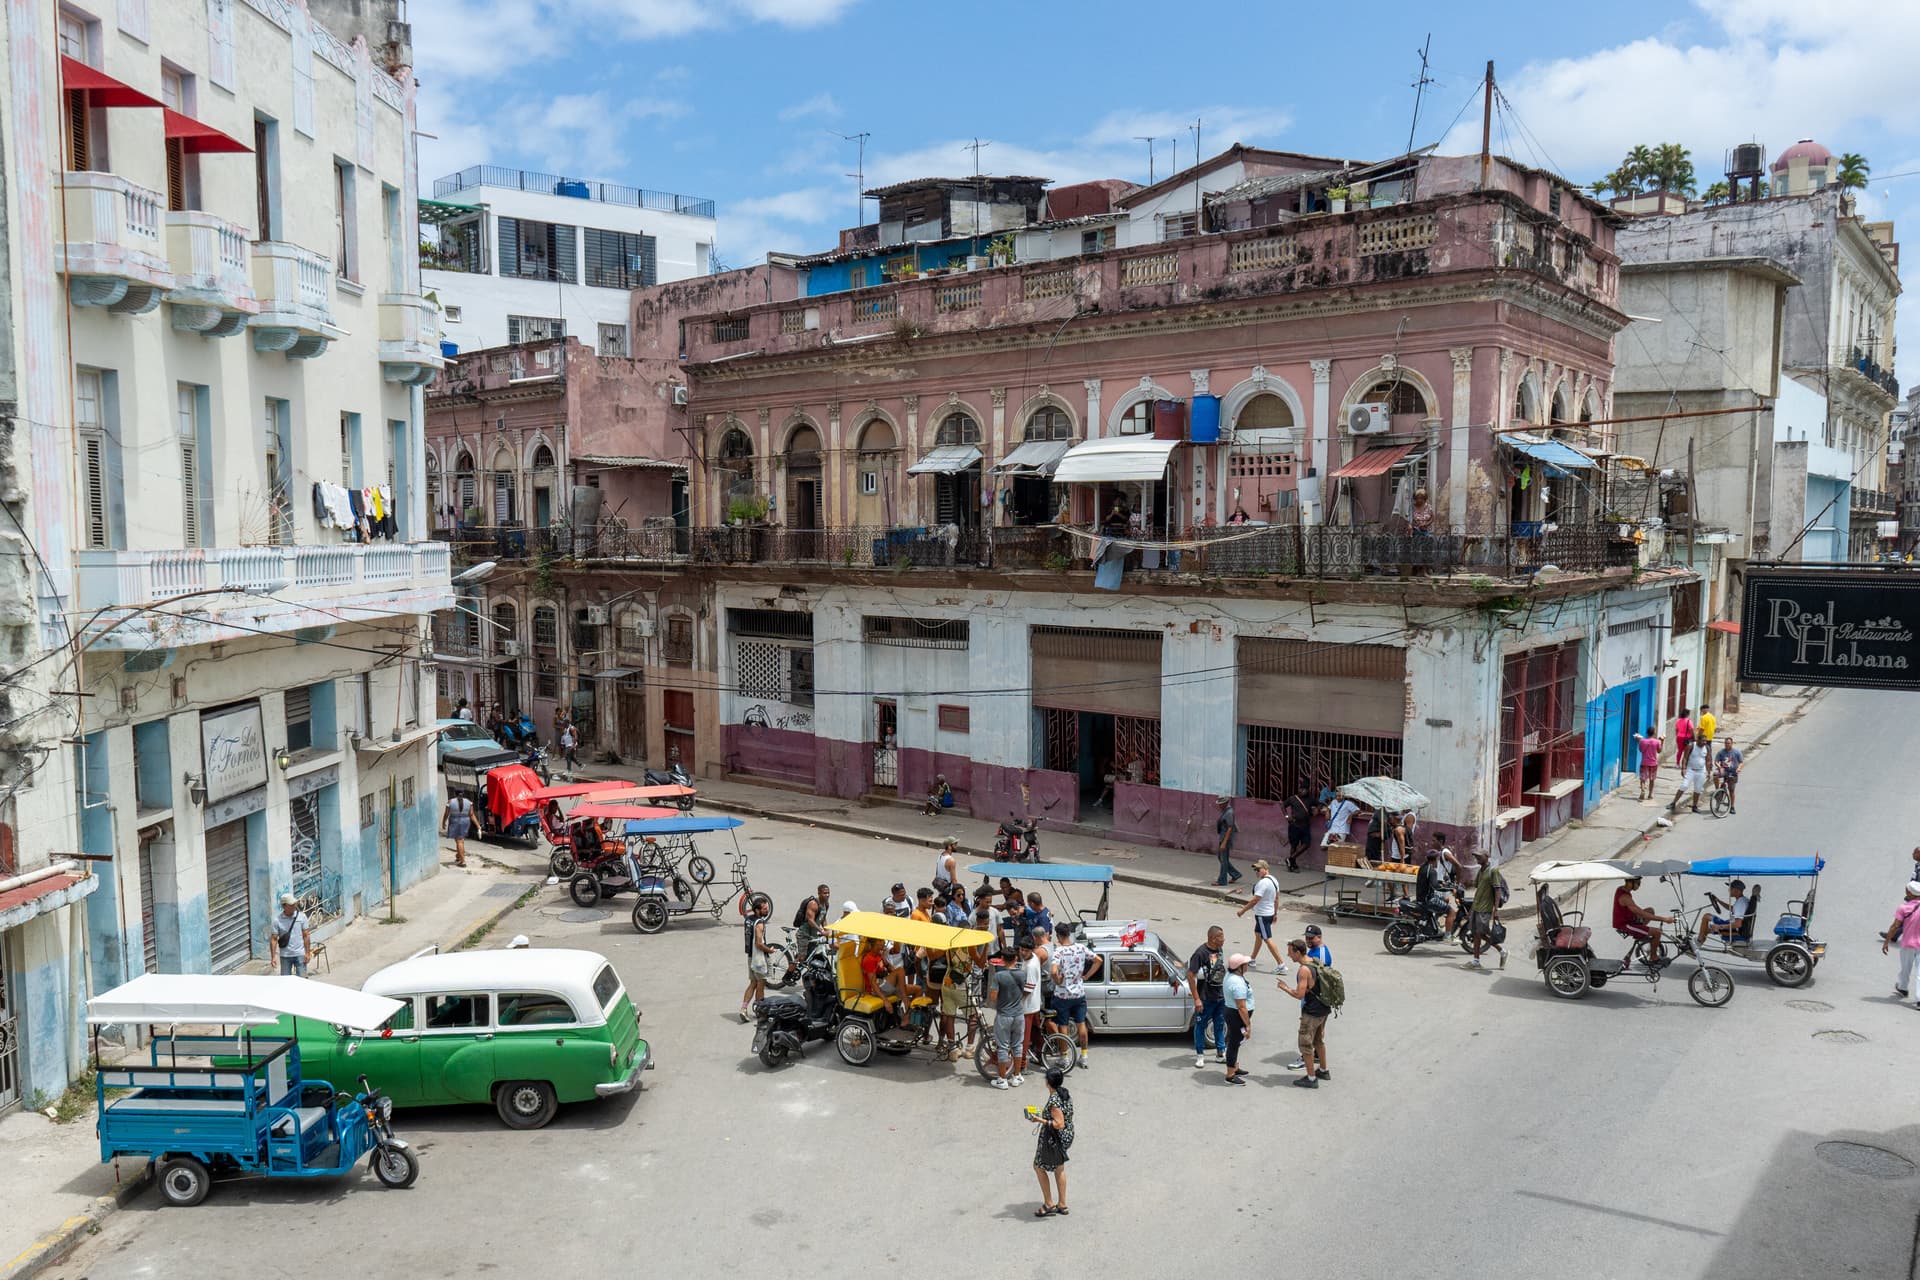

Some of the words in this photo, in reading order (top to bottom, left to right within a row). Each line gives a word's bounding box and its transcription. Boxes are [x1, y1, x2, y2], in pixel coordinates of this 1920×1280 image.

[1764, 599, 1834, 640] Real
[1835, 622, 1913, 642] Restaurante
[1792, 625, 1909, 669] Habana
